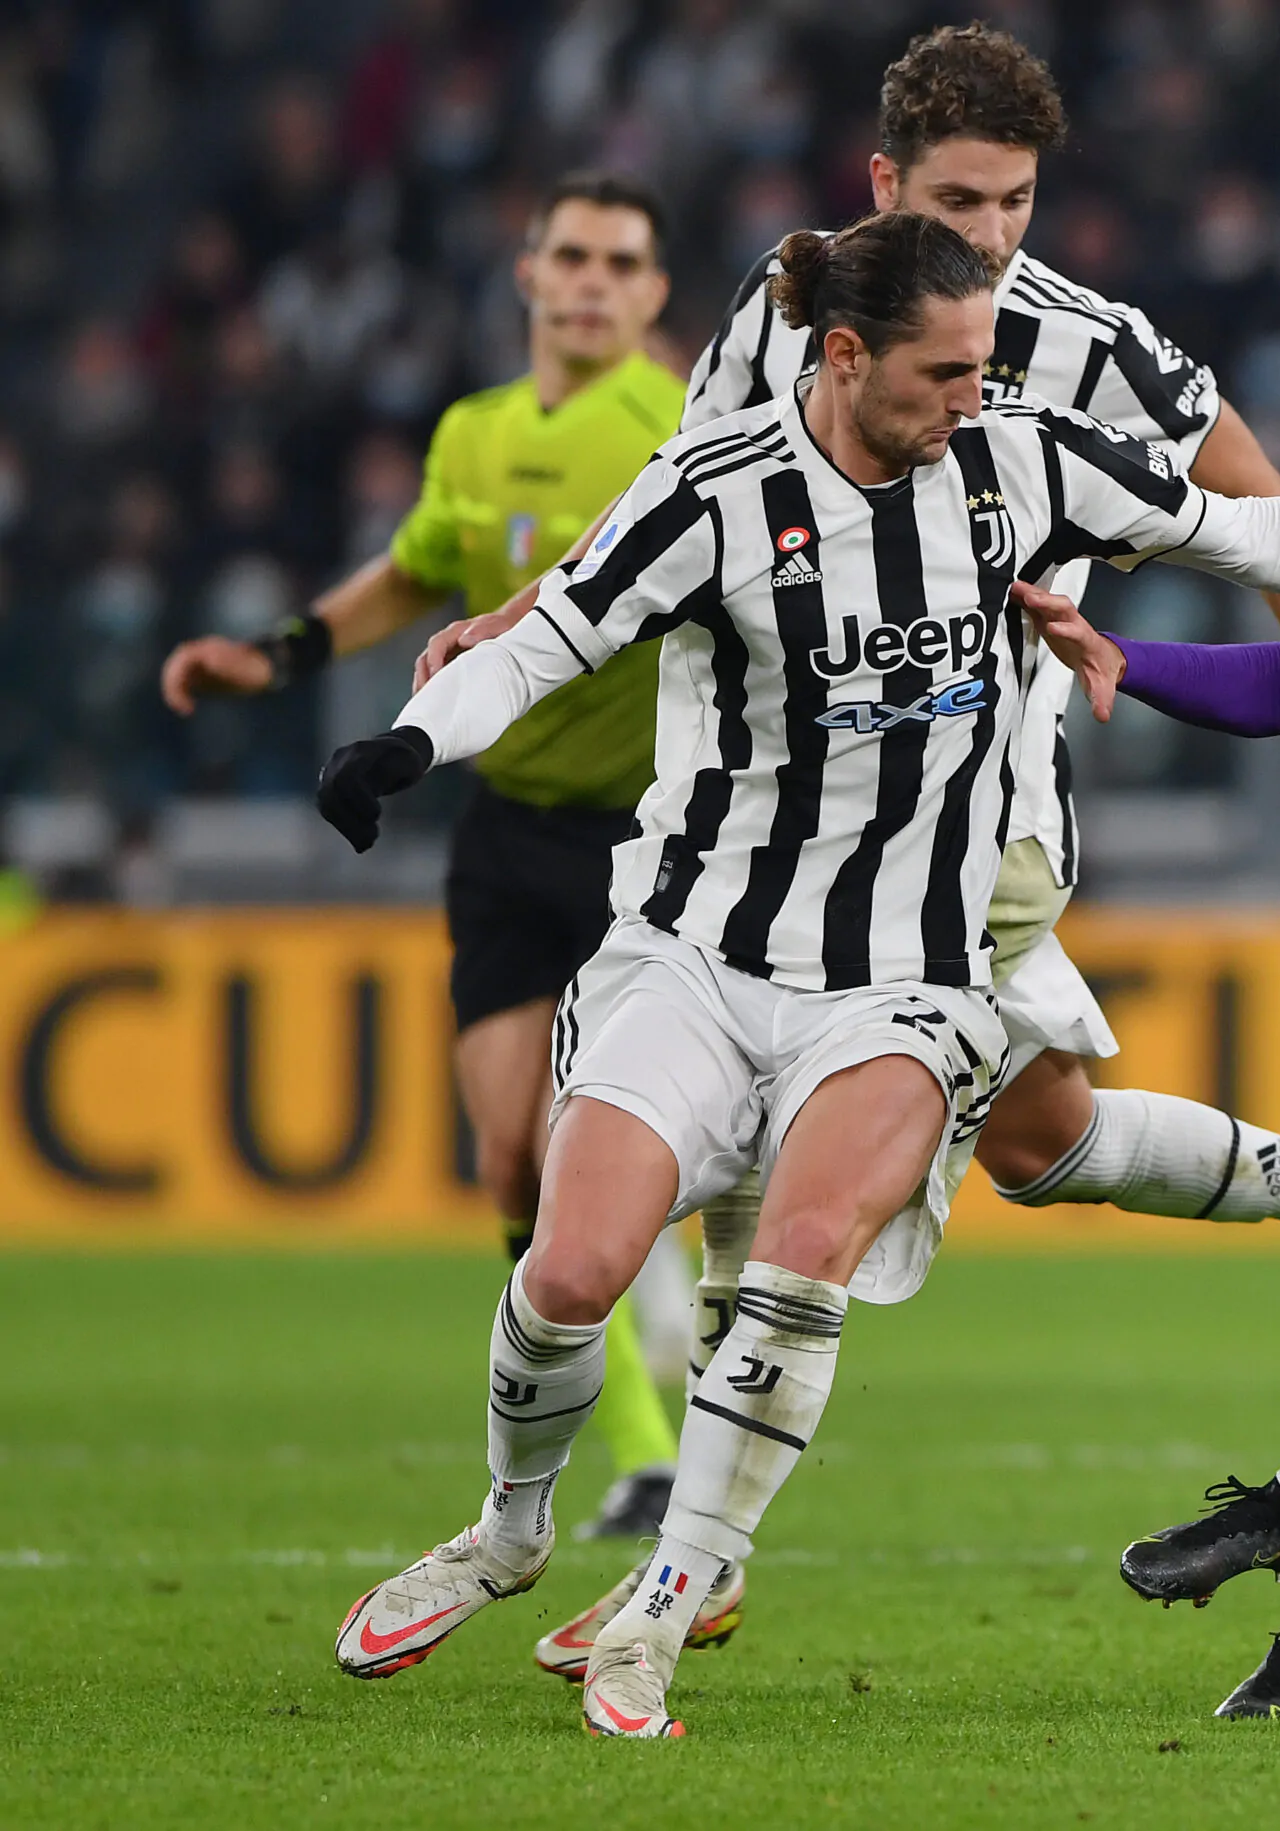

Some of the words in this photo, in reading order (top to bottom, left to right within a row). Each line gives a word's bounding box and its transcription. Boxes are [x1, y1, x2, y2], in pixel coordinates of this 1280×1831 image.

[771, 570, 824, 588] adidas
[810, 610, 987, 679] Jeep
[18, 960, 482, 1196] CU
[649, 1589, 674, 1610] AR
[644, 1602, 664, 1619] 25
